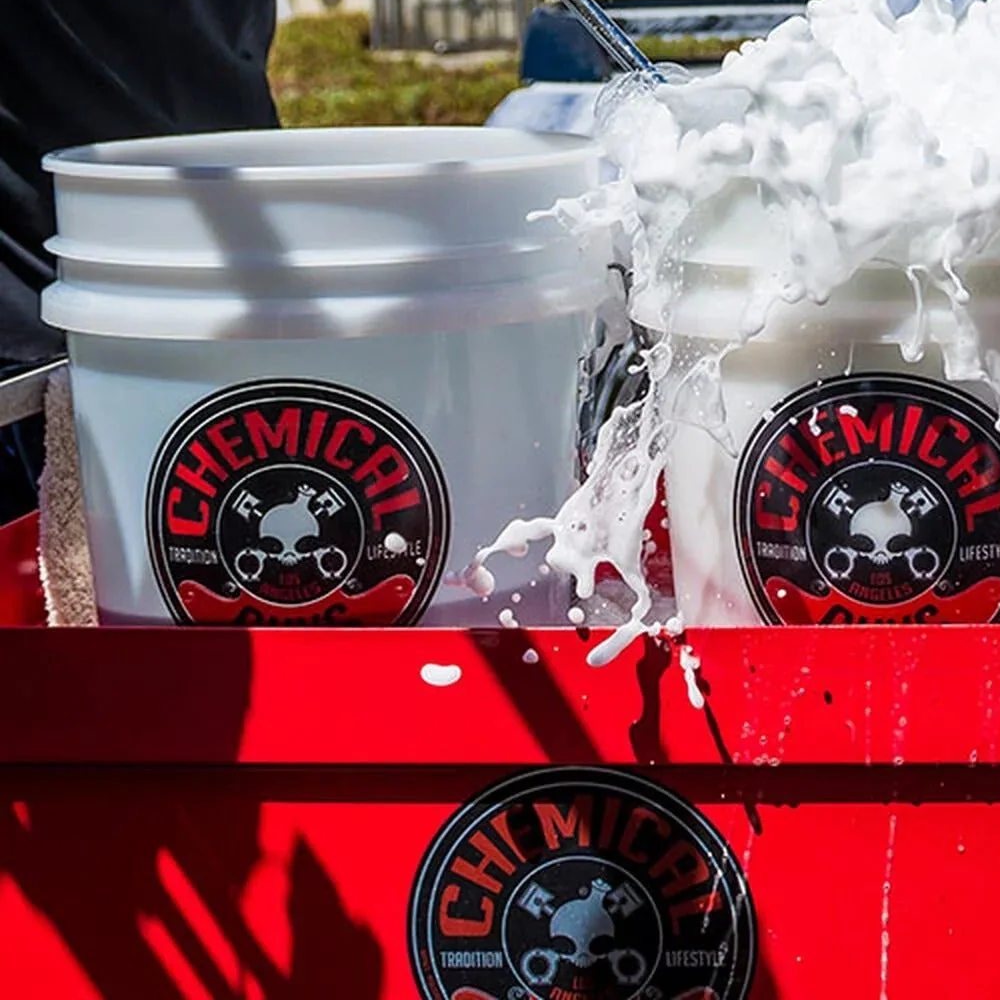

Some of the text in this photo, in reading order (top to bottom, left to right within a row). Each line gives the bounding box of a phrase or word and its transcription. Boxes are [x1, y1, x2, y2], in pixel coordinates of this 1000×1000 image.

[167, 408, 420, 536] CHEMICAL
[367, 540, 421, 560] LIFESLE
[757, 541, 807, 561] TRADITION
[439, 795, 723, 937] CHEMICAL
[440, 951, 503, 968] TRADITION
[665, 949, 726, 968] LIFESTYLE
